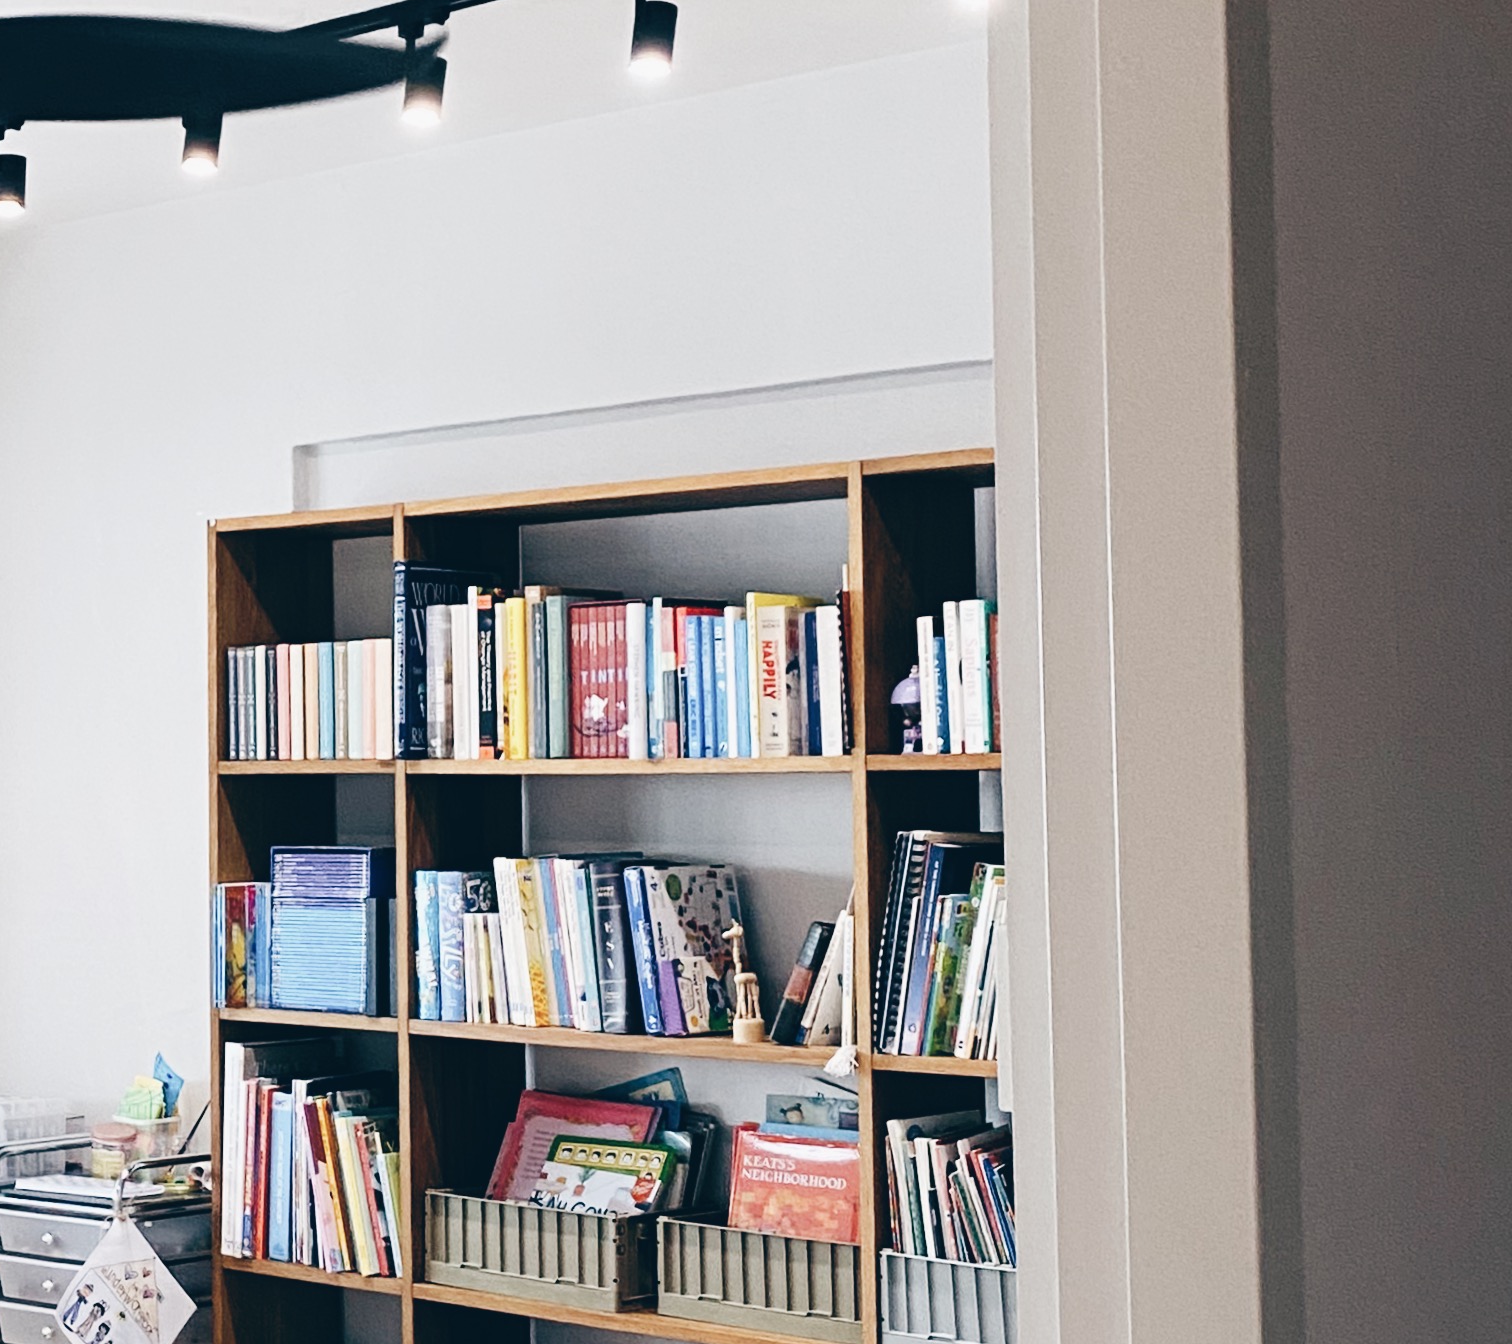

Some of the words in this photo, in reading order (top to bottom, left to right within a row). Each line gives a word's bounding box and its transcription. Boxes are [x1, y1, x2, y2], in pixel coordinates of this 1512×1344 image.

[762, 640, 777, 699] HAPPILY
[964, 638, 979, 697] Sapiens
[742, 1168, 847, 1190] NEIGHBORHOOD
